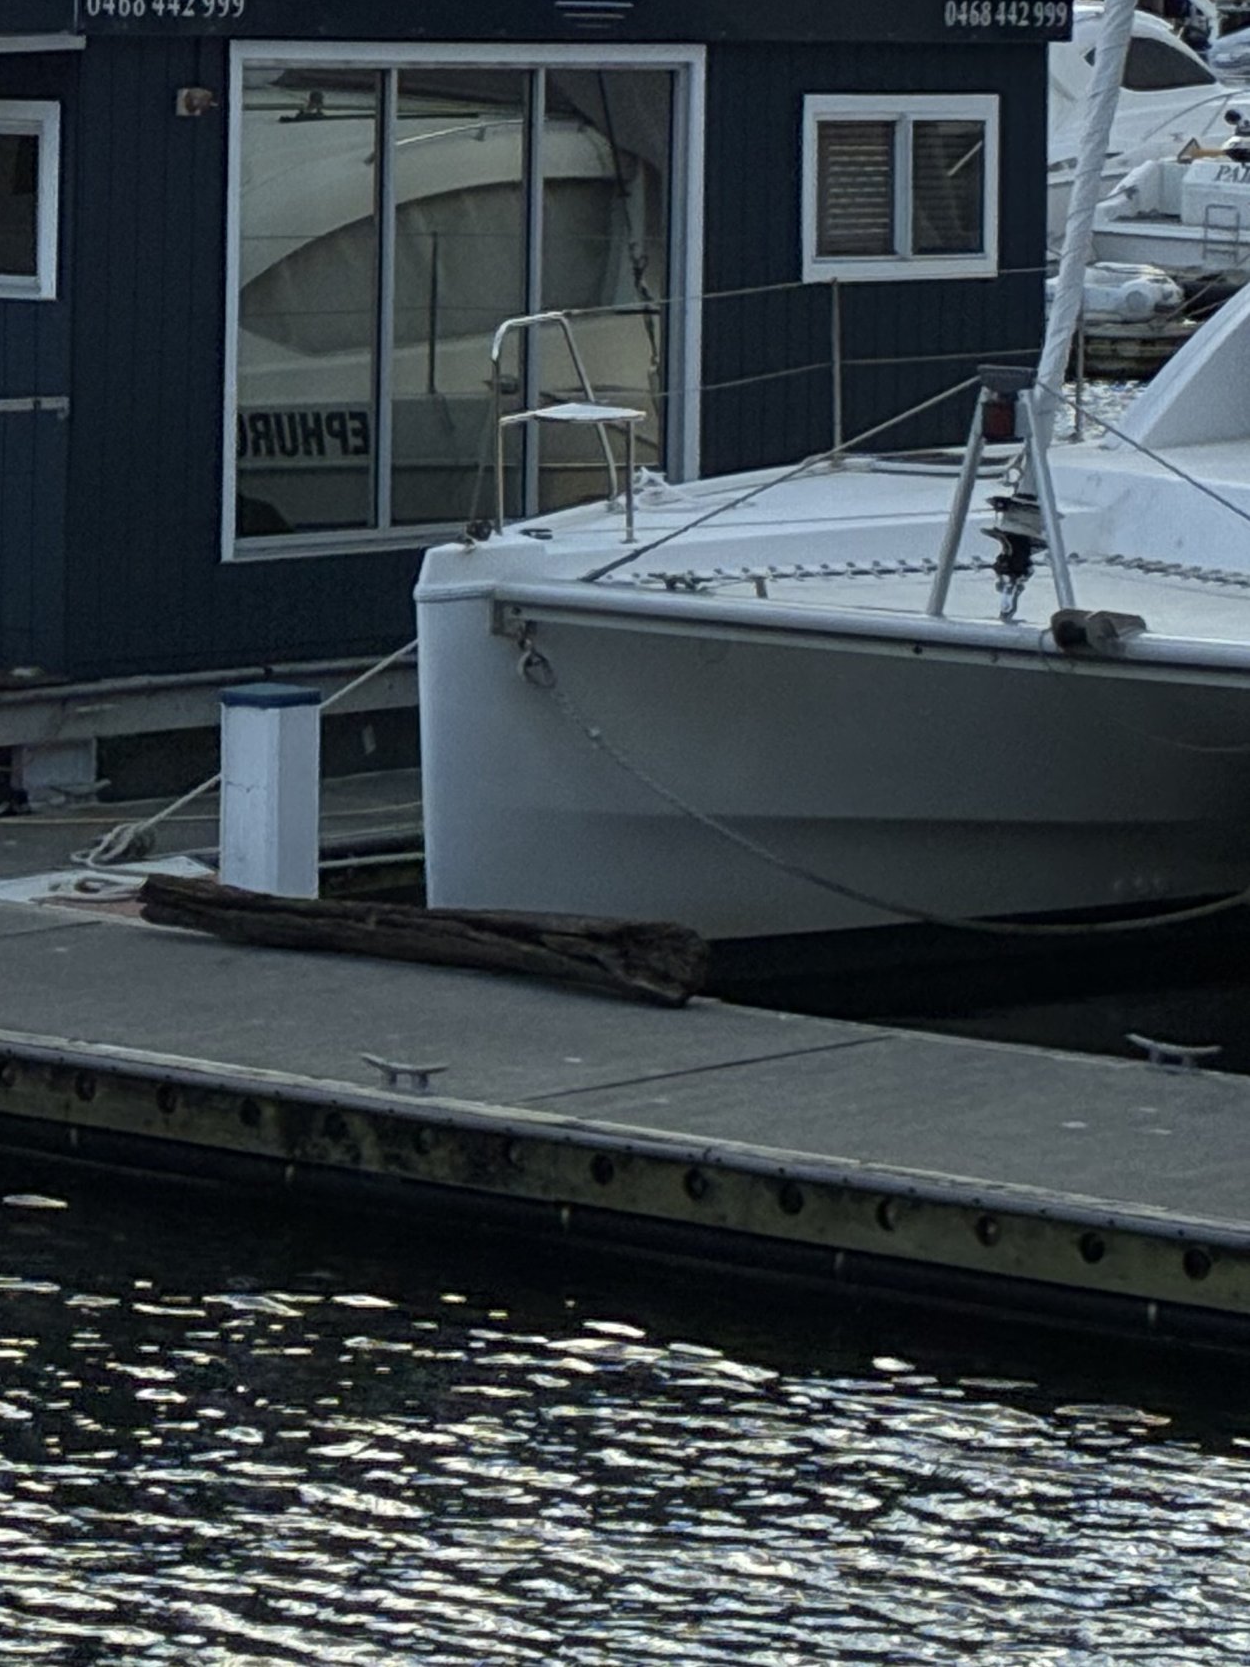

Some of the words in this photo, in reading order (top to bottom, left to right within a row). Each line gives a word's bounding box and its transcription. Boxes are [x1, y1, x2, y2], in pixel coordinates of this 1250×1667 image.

[944, 0, 992, 27] 0468
[995, 1, 1030, 27] 442
[1033, 2, 1068, 27] 999
